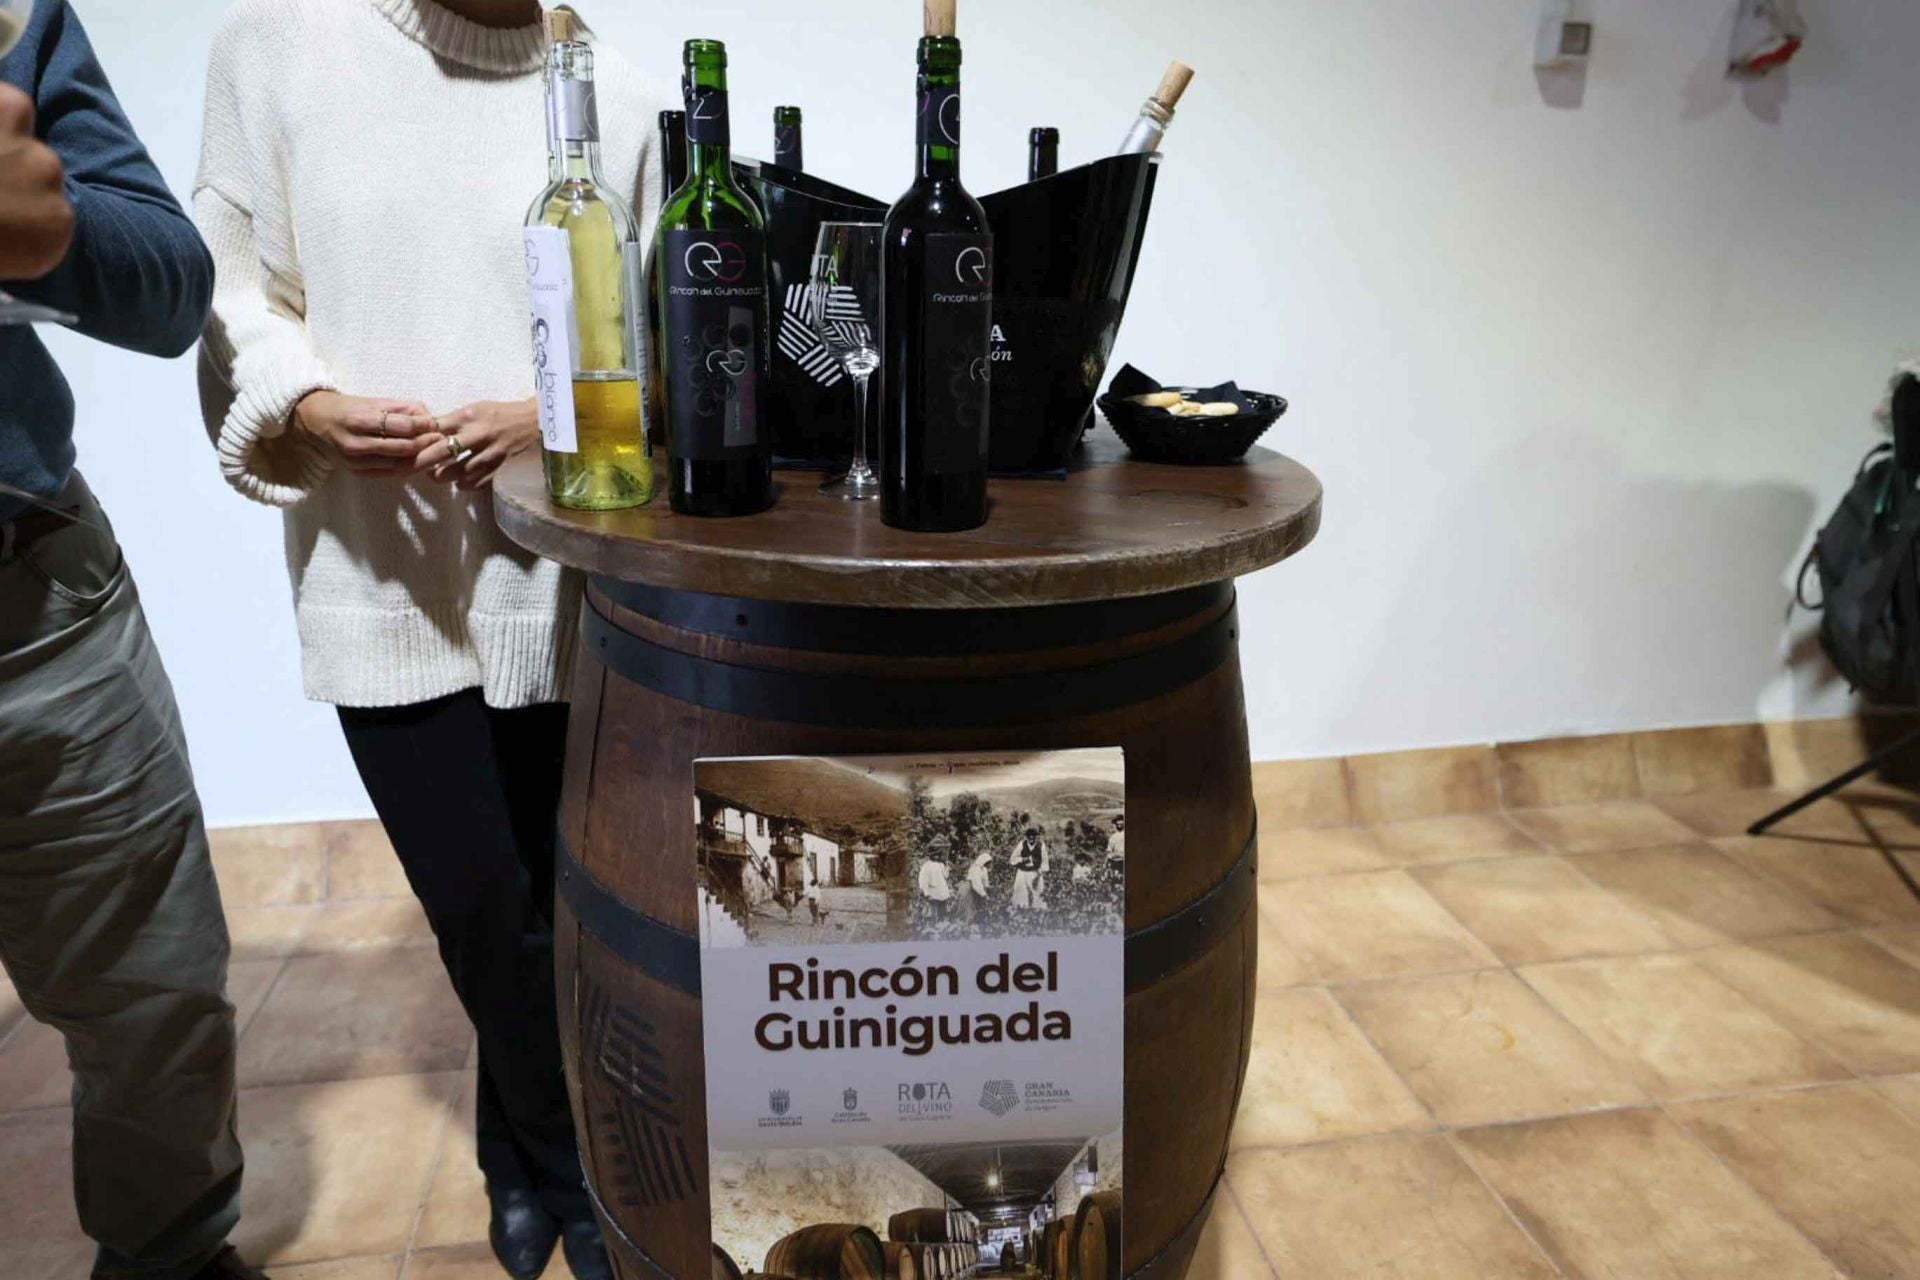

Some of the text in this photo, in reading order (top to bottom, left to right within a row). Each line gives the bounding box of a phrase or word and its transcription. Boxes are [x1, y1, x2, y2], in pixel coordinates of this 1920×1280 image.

[768, 951, 1058, 1002] Rincón del
[754, 1001, 1072, 1056] Guiniguada
[1025, 1082, 1053, 1090] GRAN
